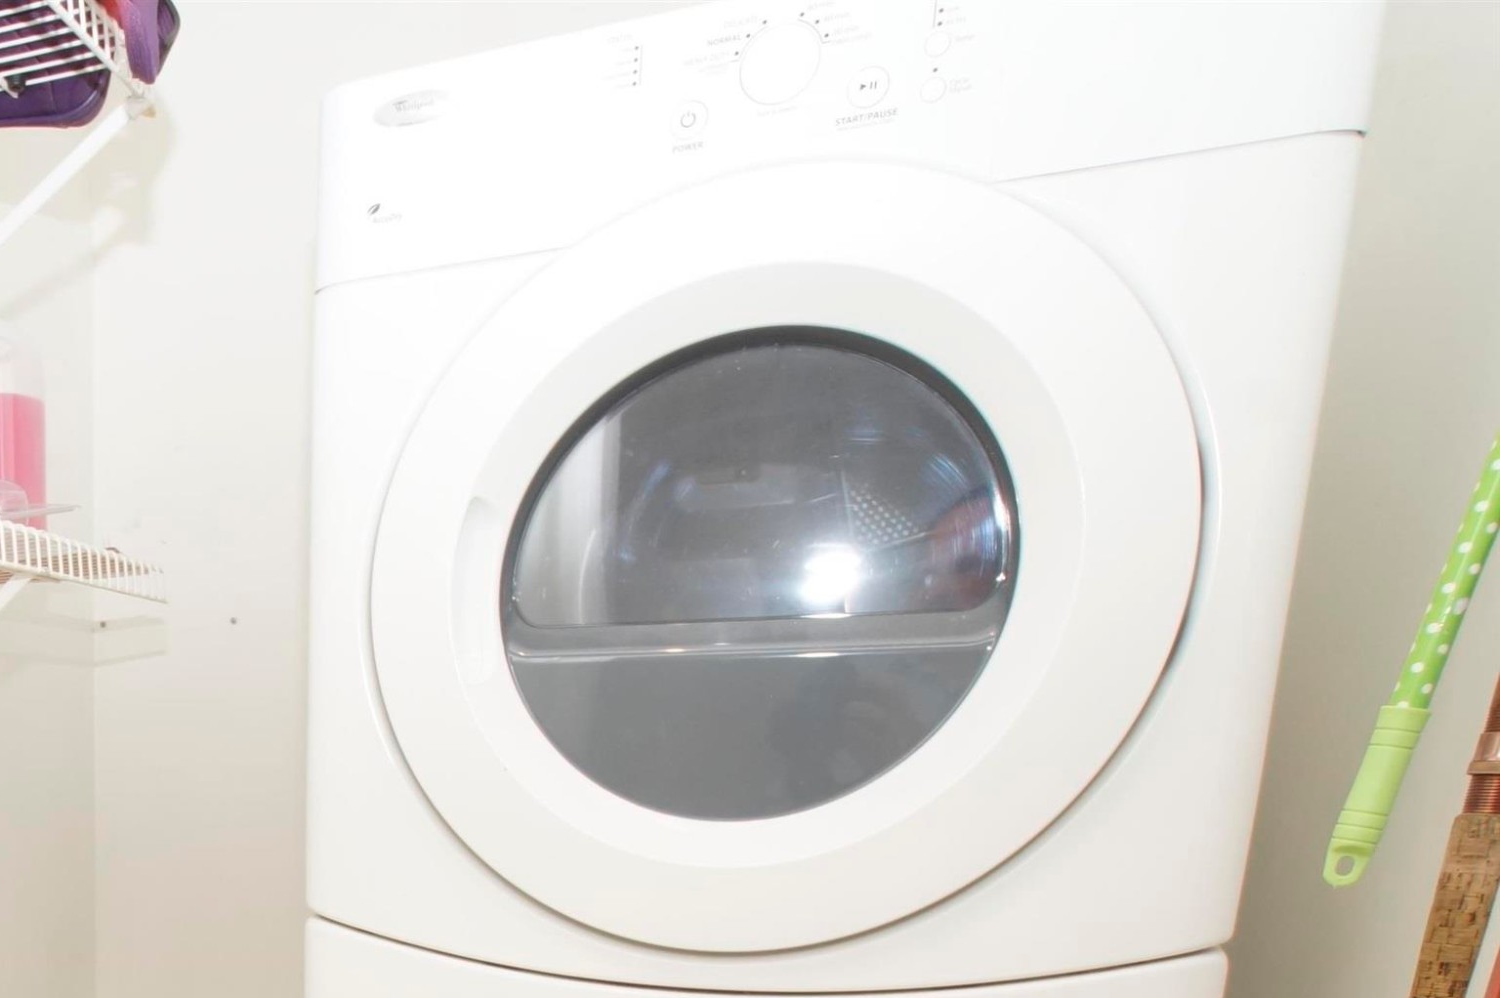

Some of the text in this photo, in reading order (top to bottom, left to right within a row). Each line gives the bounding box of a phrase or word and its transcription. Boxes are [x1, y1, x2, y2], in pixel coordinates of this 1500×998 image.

[707, 34, 742, 47] NORMAL
[835, 107, 899, 127] START/PAUSE
[671, 140, 704, 154] POWER
